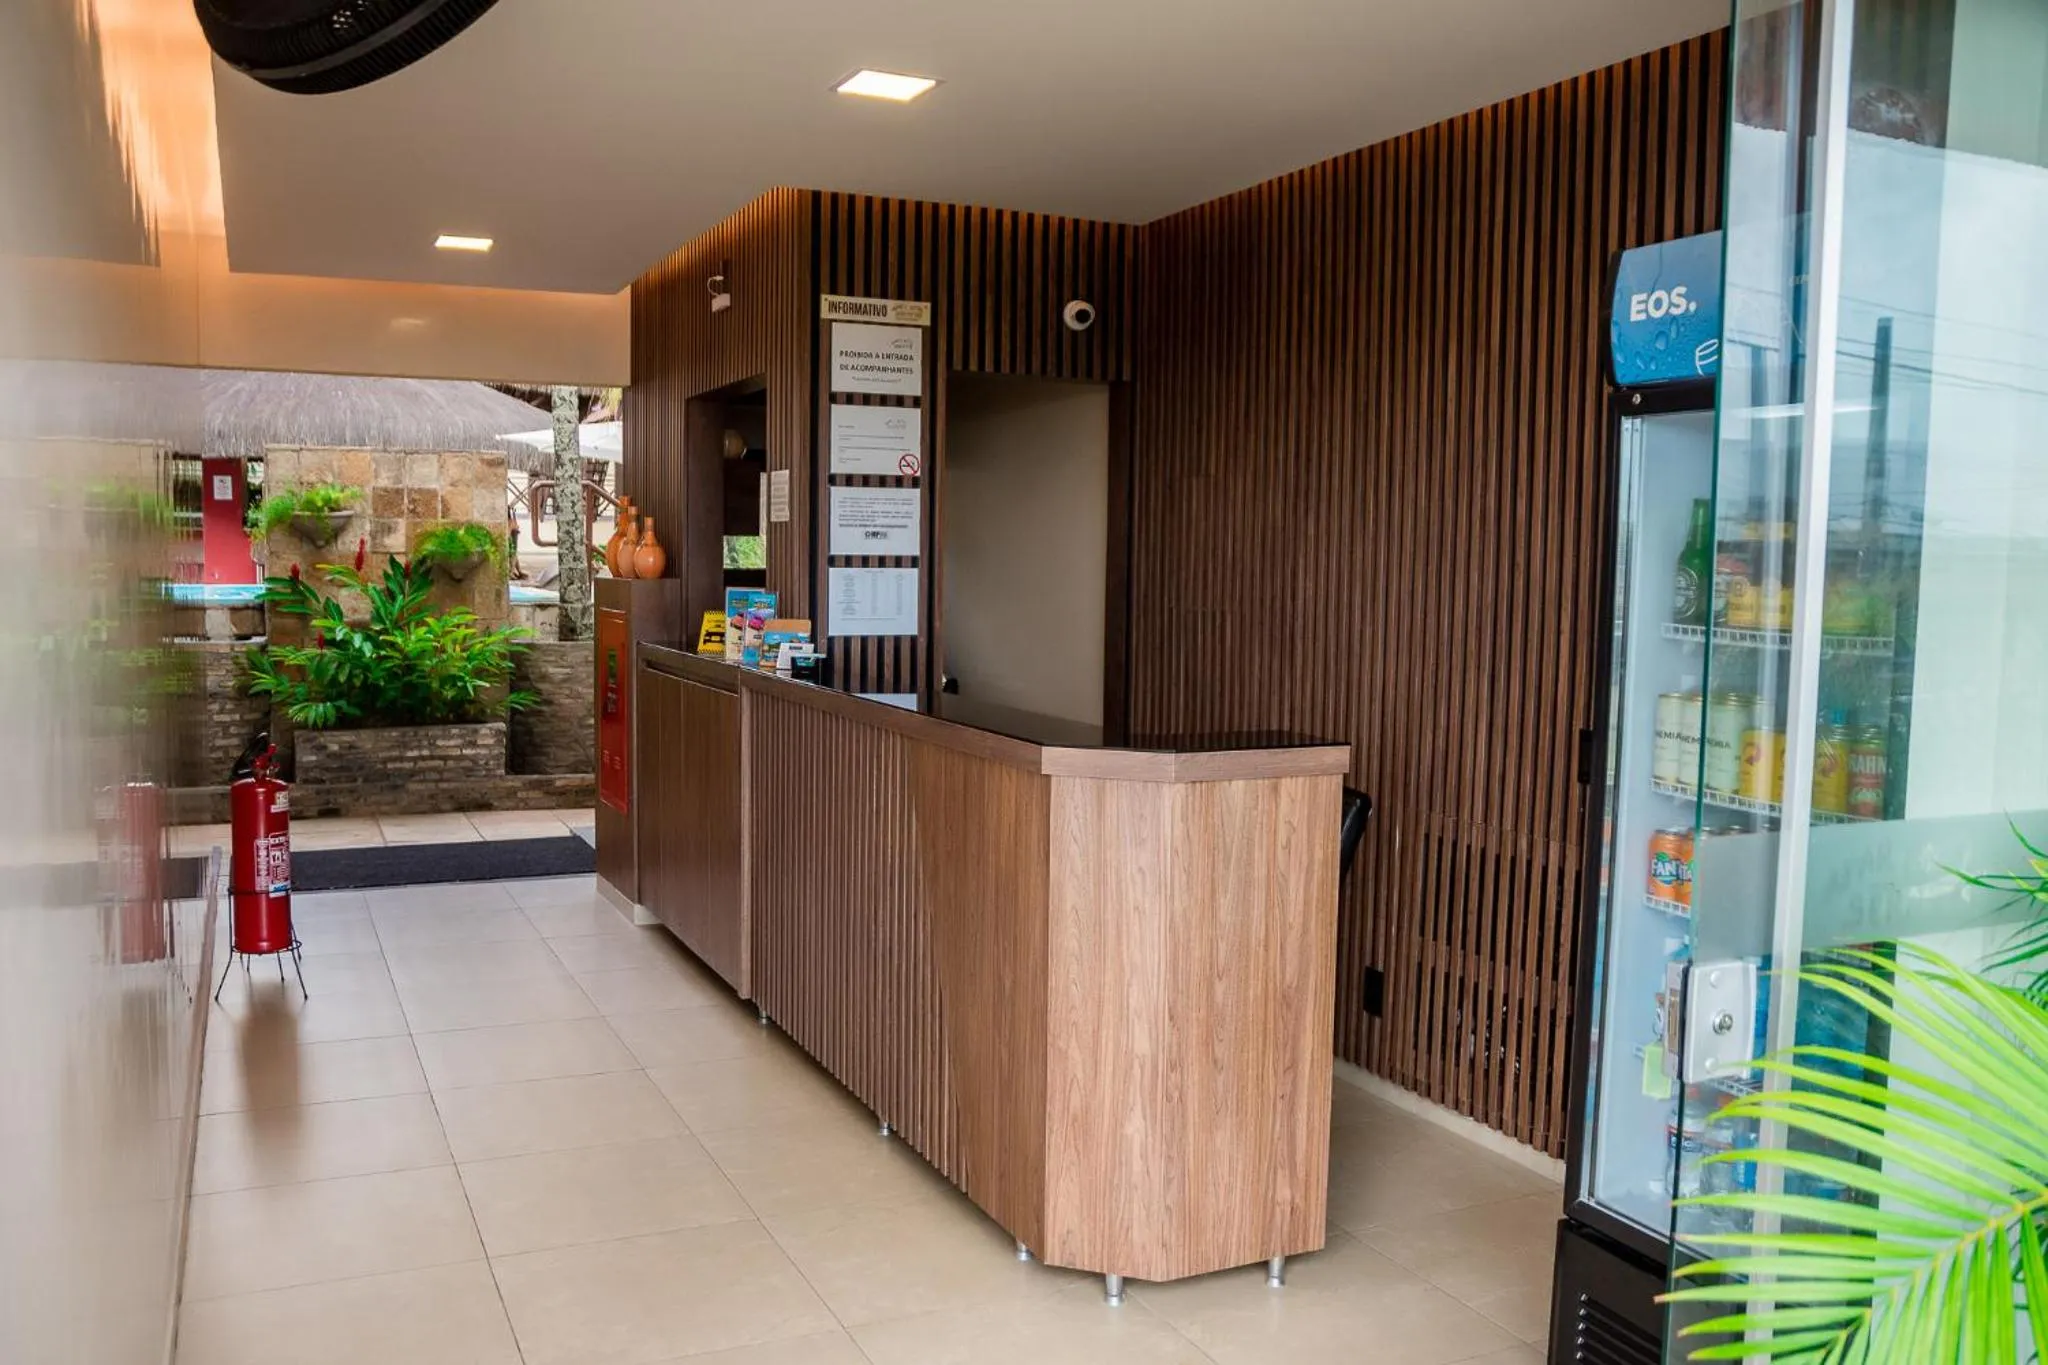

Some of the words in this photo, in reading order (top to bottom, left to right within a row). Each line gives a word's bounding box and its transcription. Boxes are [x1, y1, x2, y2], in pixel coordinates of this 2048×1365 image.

[828, 301, 888, 318] INFORMATIVO
[1630, 286, 1697, 322] EOS.
[875, 351, 880, 359] A
[881, 352, 914, 362] ENTRADA
[850, 364, 914, 376] ACOMPANHANTES
